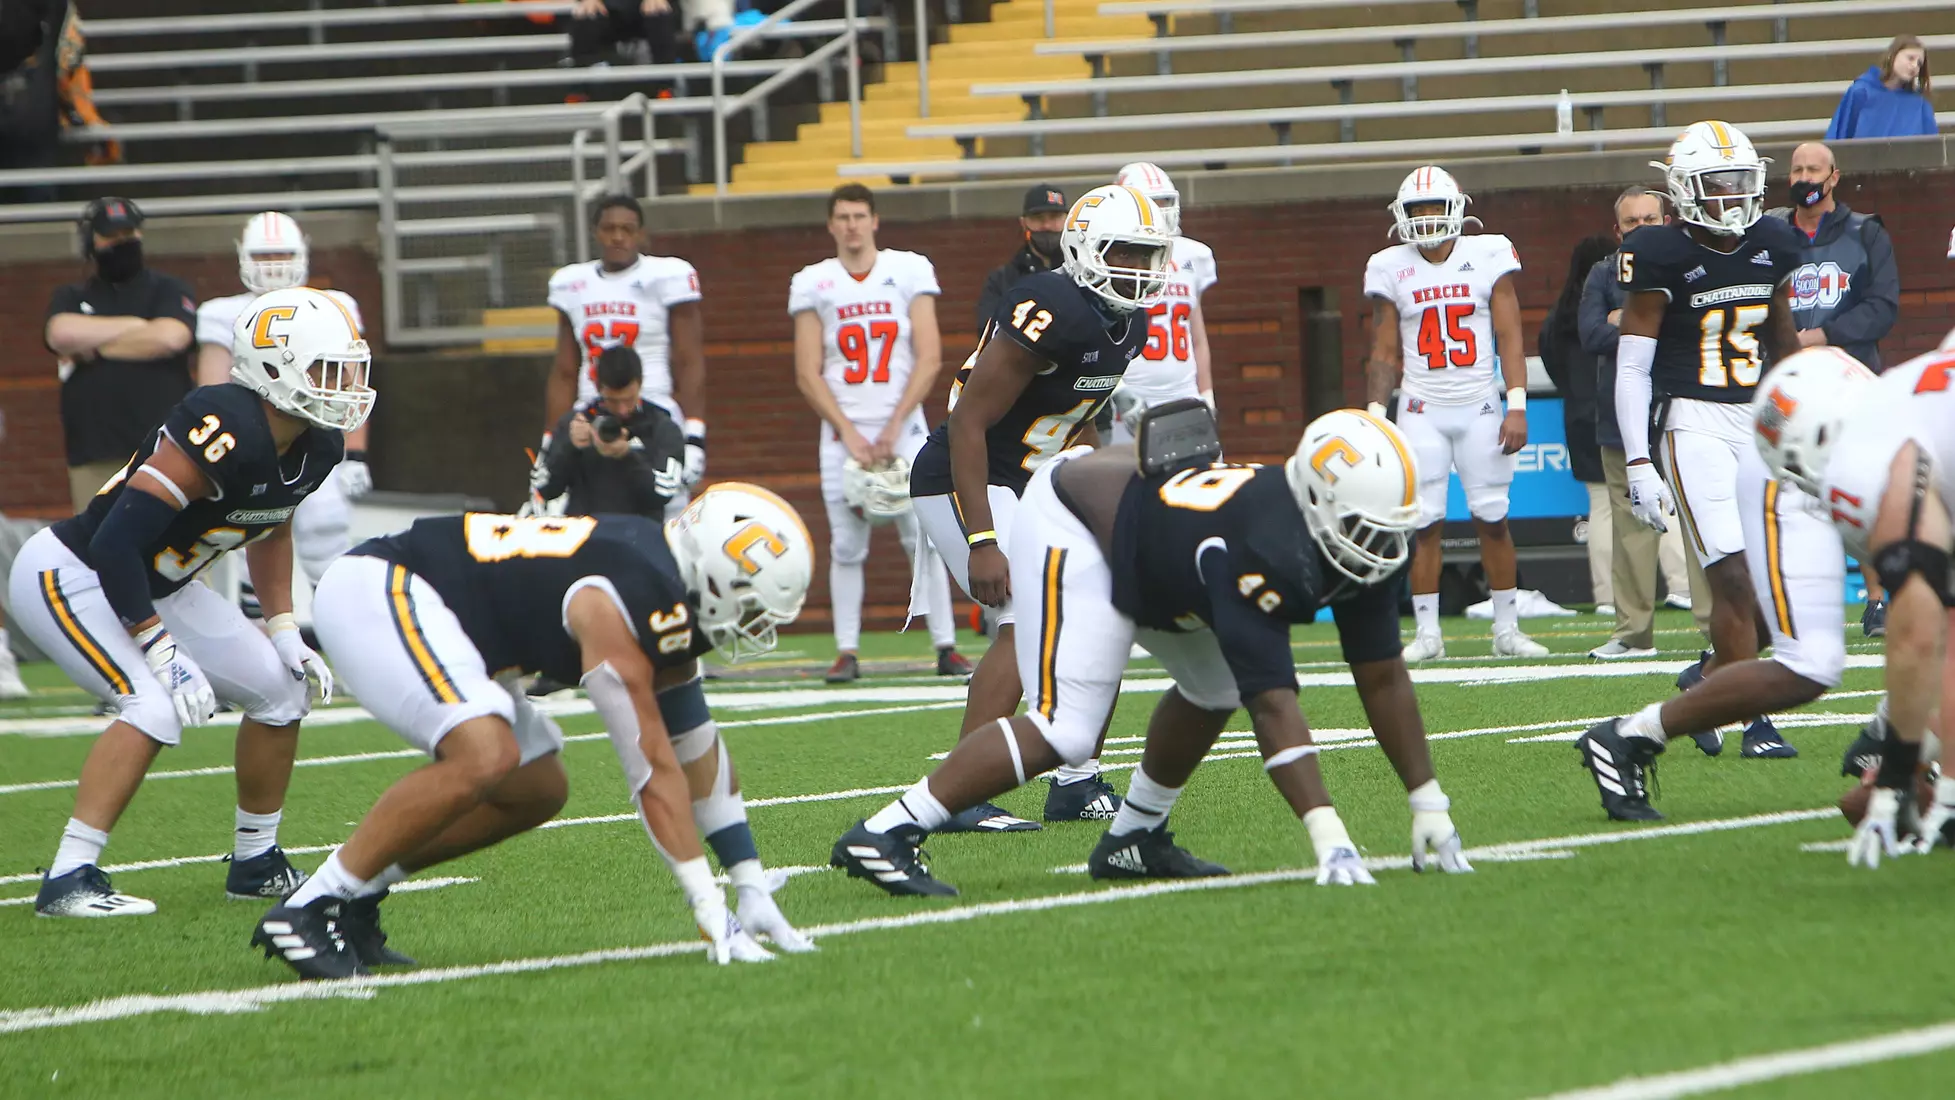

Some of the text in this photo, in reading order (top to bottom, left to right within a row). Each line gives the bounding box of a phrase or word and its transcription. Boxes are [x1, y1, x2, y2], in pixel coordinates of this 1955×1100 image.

[1067, 194, 1106, 232] C
[1616, 252, 1636, 284] 15
[836, 301, 893, 320] MERCER
[1412, 283, 1471, 304] MERCER
[1693, 285, 1773, 305] CHATTANOOGA
[252, 305, 299, 350] C
[1011, 299, 1054, 343] 42
[1141, 302, 1192, 362] 56
[1417, 302, 1478, 370] 45
[837, 320, 899, 384] 97
[1698, 304, 1770, 388] 15
[187, 413, 237, 464] 36
[1513, 443, 1572, 472] ER
[1311, 436, 1365, 487] C
[1828, 485, 1865, 529] 77
[722, 521, 789, 577] C
[648, 602, 693, 655] 38
[1107, 855, 1148, 875] adidas
